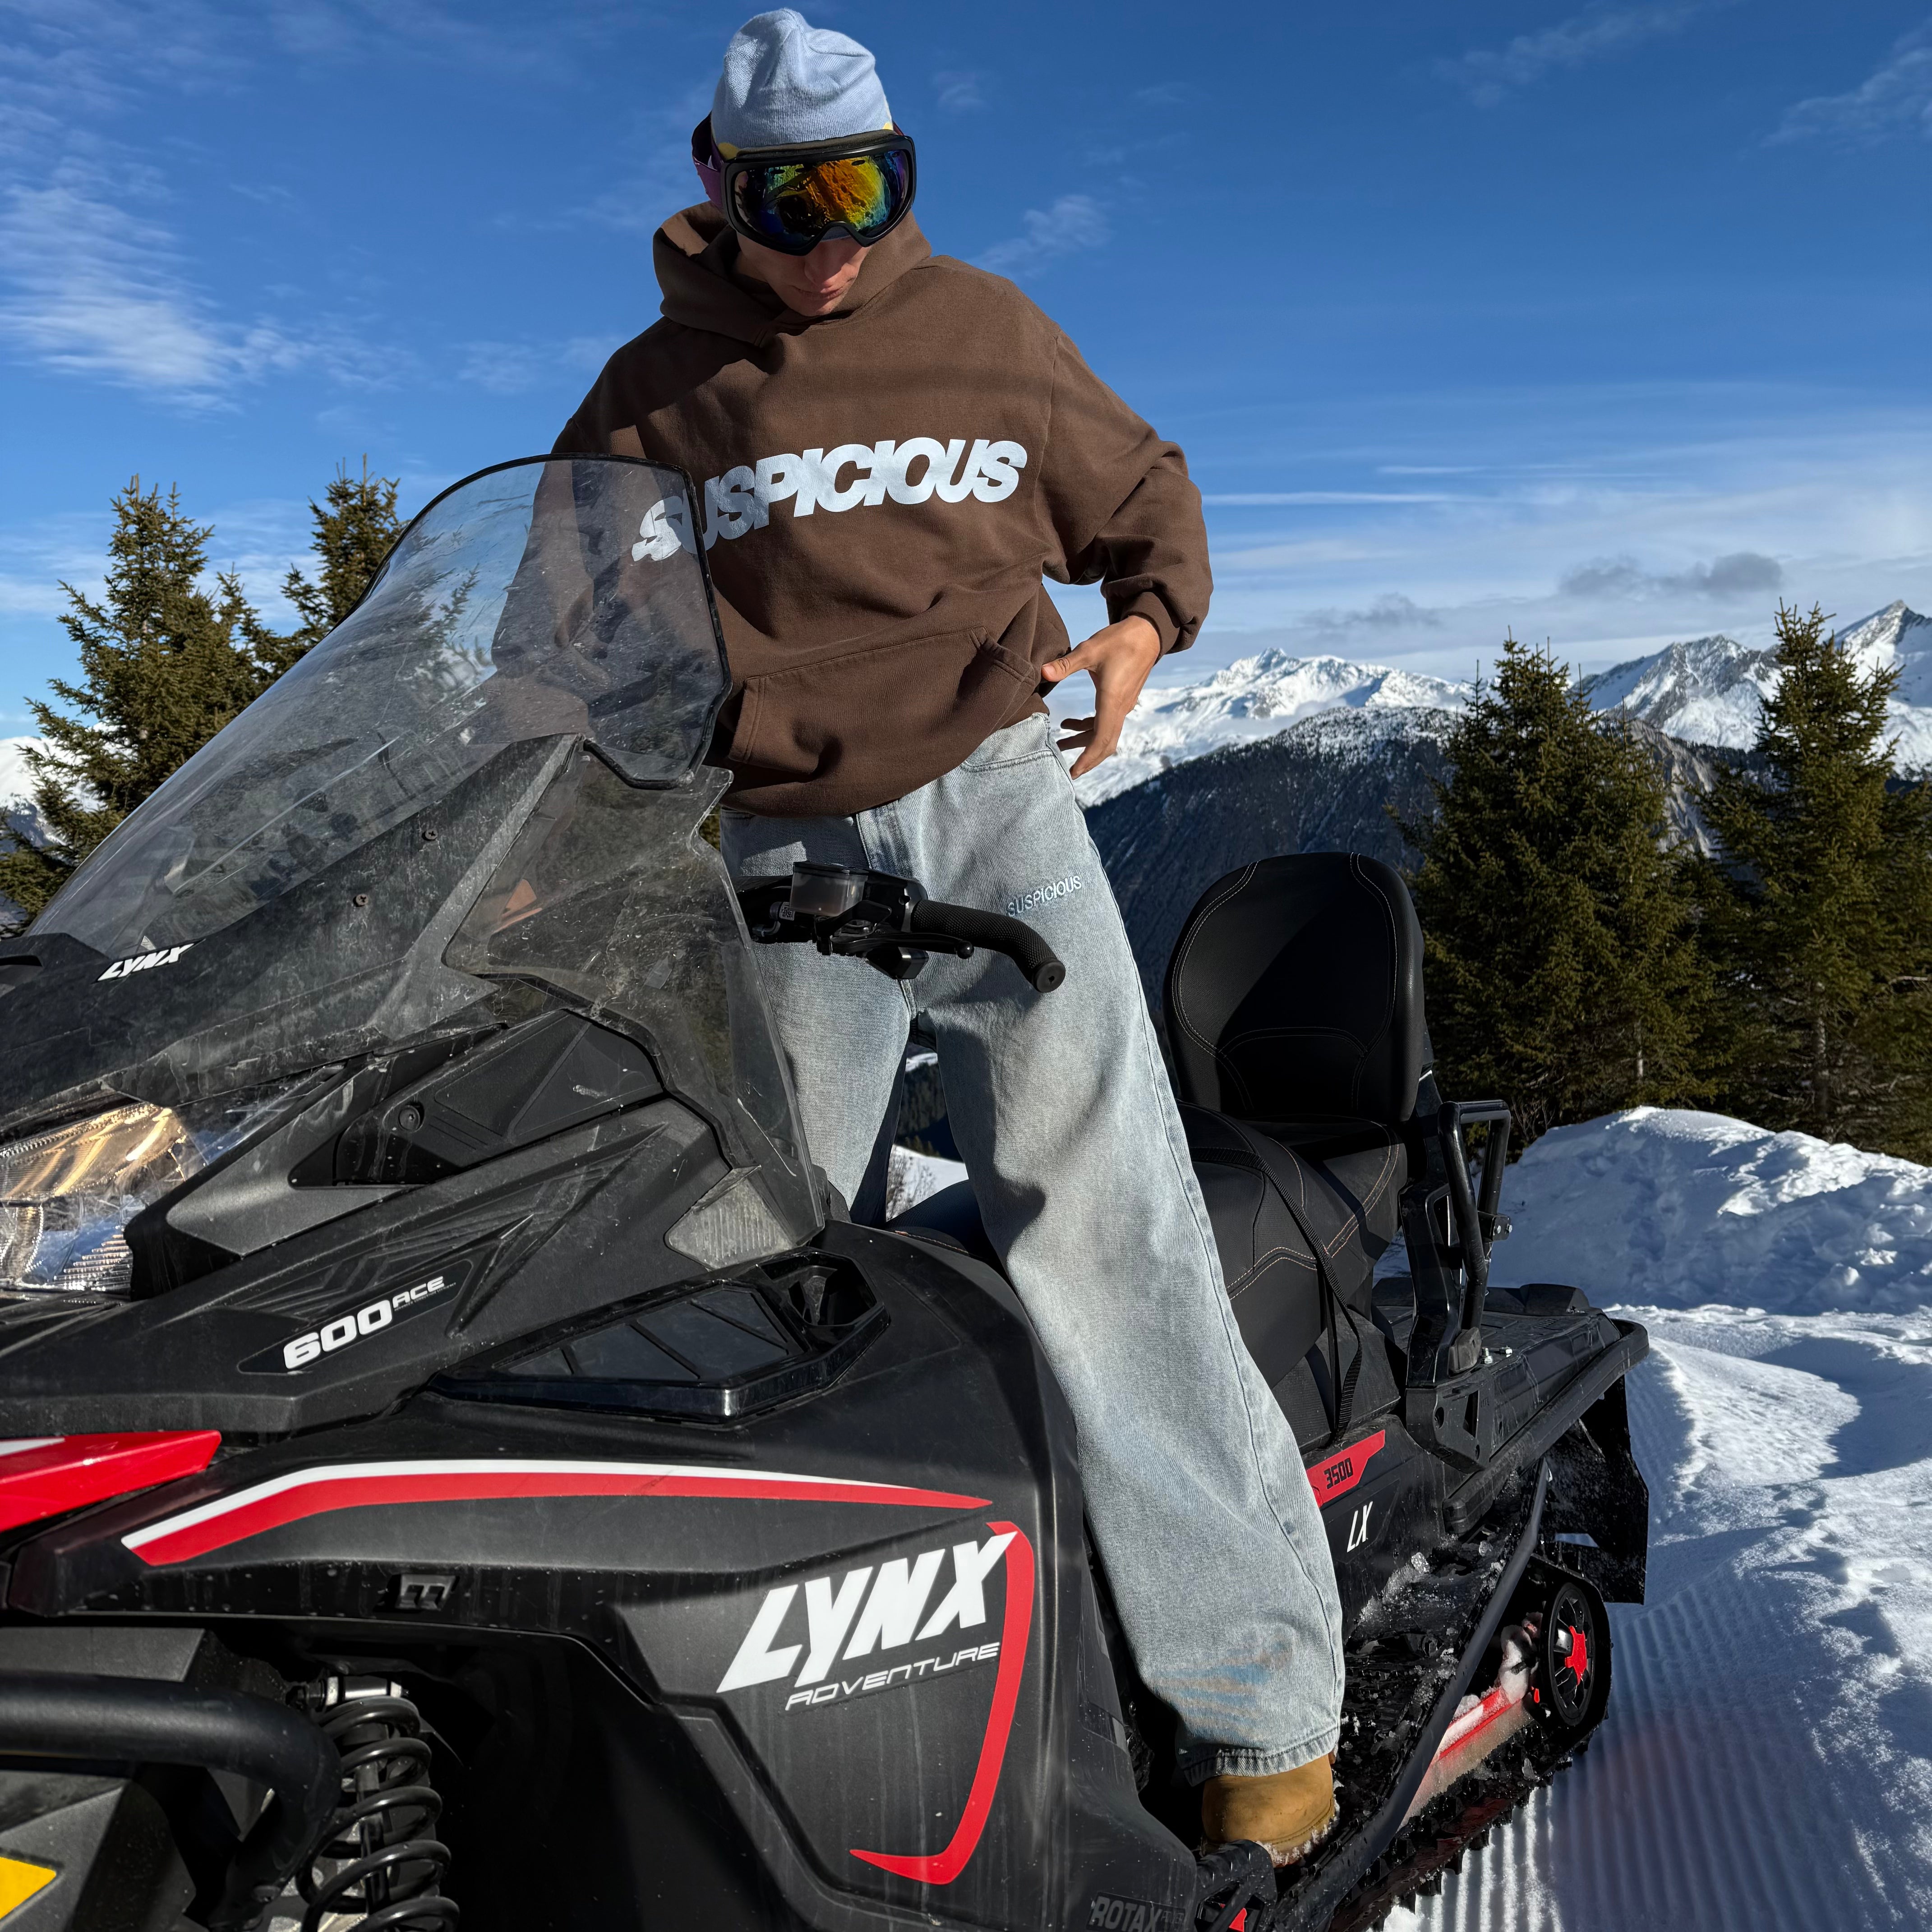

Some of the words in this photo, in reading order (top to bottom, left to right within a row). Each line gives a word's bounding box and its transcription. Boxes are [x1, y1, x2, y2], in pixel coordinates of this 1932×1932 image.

[632, 437, 1028, 562] SUSPICIOUS
[1008, 875, 1082, 916] SUSPICIOUS
[97, 943, 194, 981] LYNX
[283, 1300, 392, 1369] 600
[392, 1276, 445, 1308] ACE
[1323, 1457, 1354, 1489] 3500
[1346, 1501, 1374, 1553] LX
[716, 1531, 1018, 1693] LYNX
[785, 1642, 1000, 1711] ADVENTURE
[1088, 1896, 1162, 1932] ROTAX
